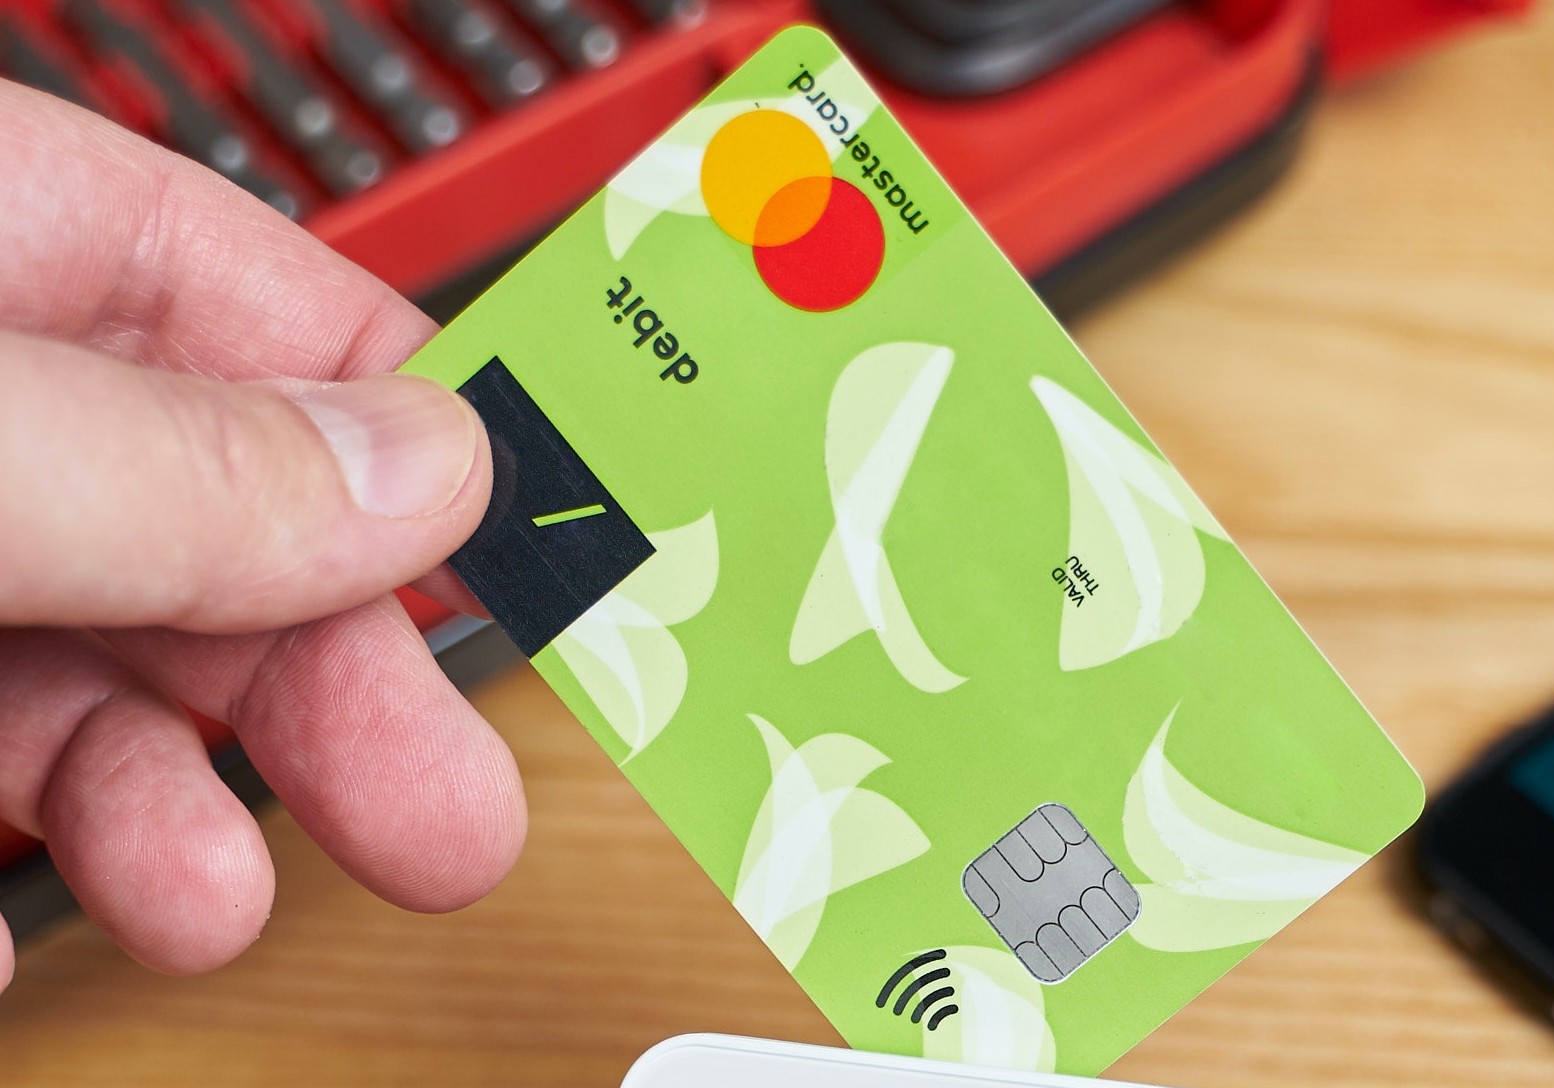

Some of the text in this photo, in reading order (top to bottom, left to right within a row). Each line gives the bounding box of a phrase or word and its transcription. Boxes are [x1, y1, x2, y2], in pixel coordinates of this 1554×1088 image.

[605, 275, 700, 386] debit
[1052, 568, 1085, 608] VALID
[1065, 556, 1099, 596] THRU
